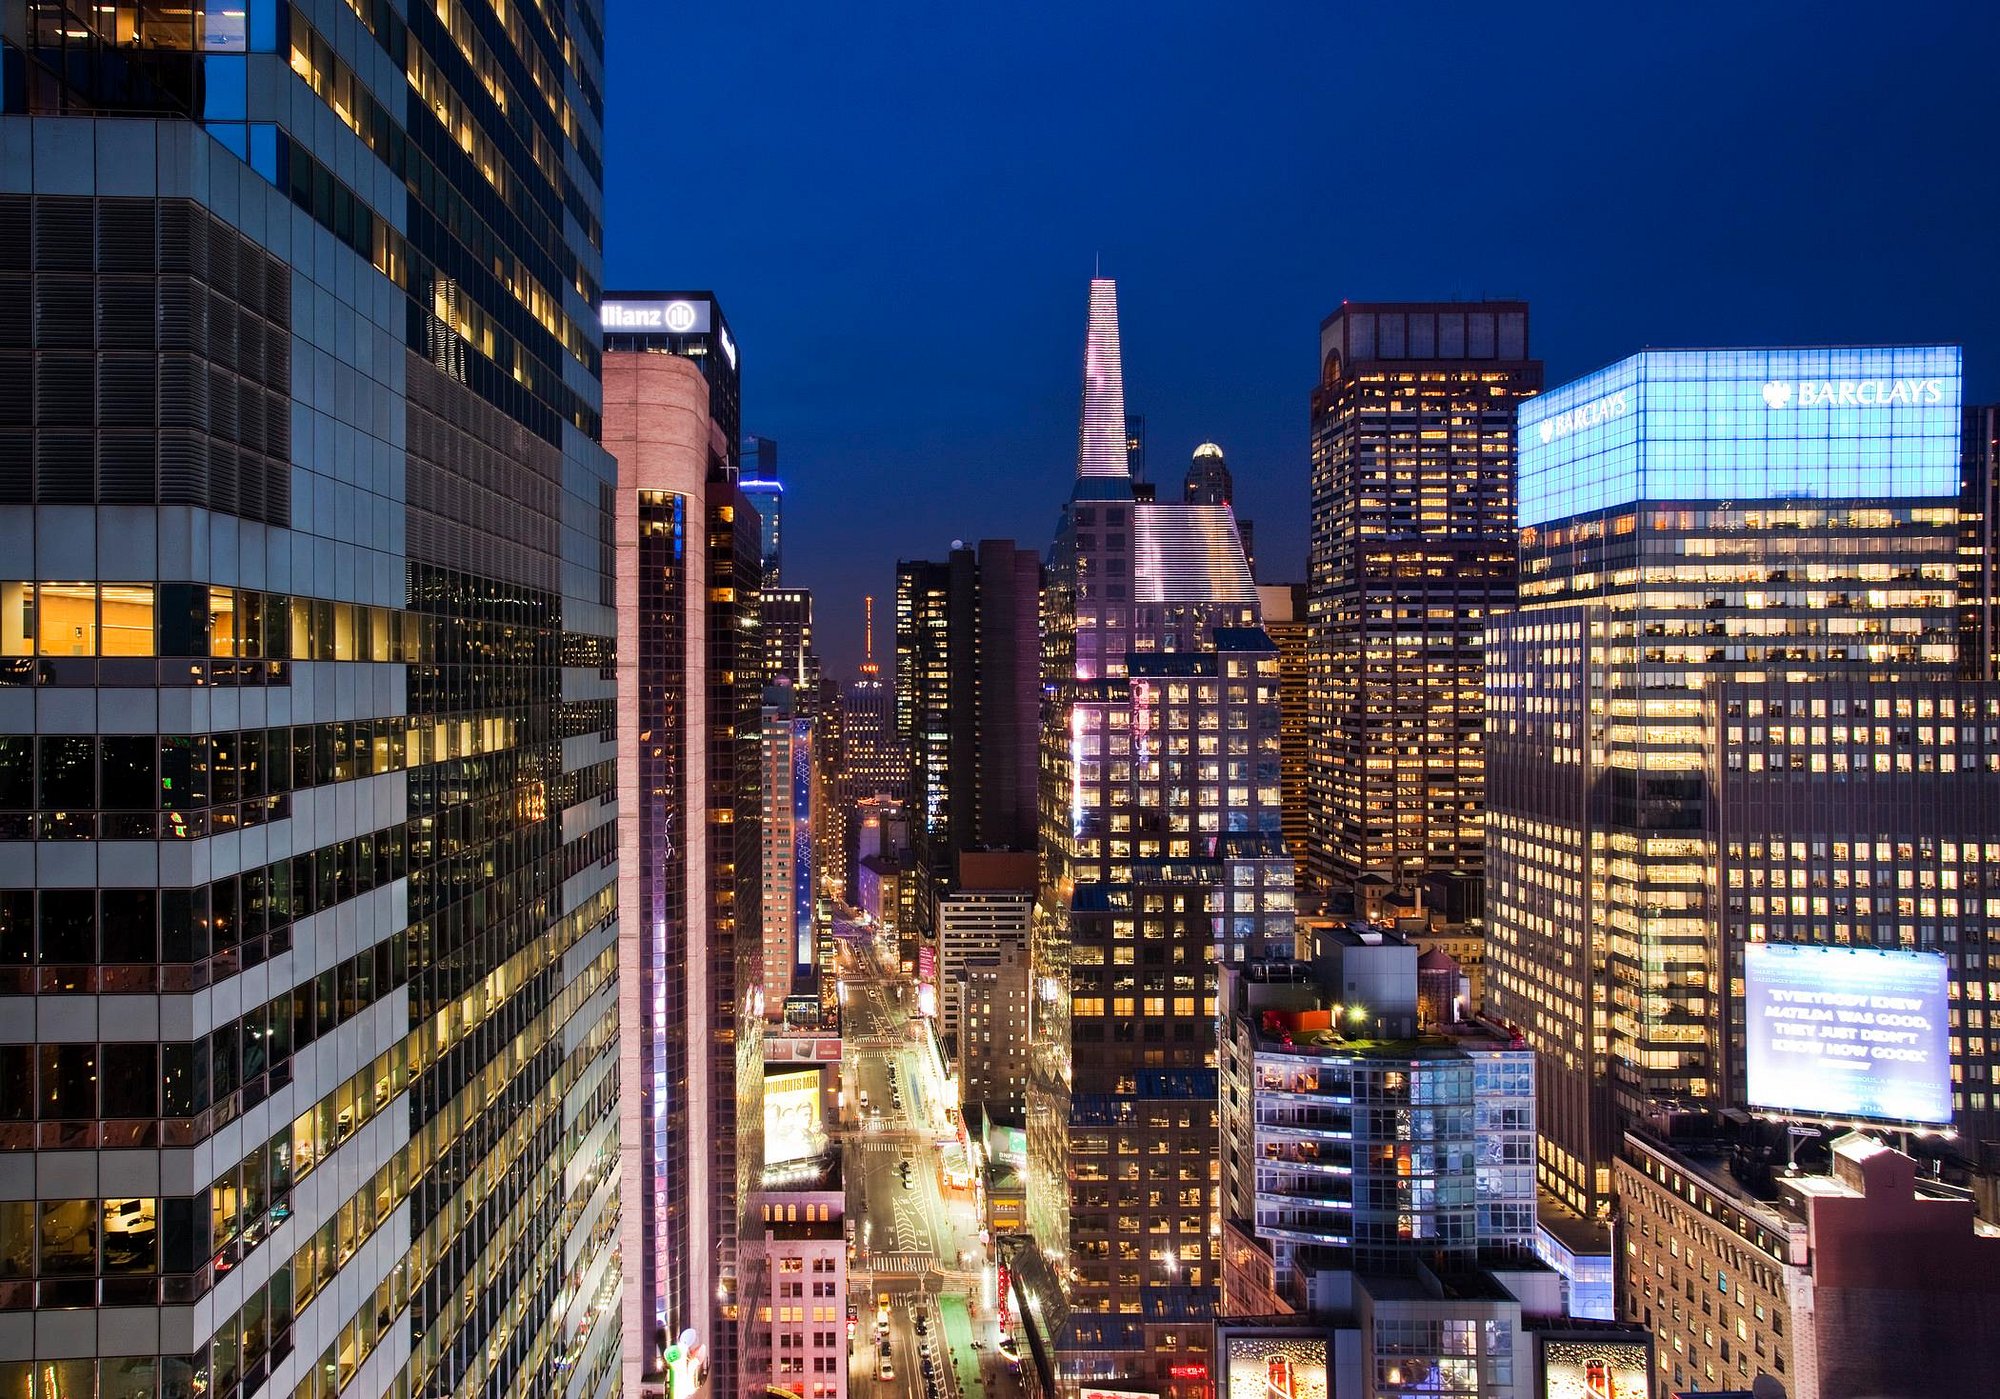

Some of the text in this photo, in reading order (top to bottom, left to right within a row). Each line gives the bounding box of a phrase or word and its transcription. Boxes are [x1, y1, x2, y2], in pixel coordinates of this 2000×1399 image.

[602, 305, 661, 325] llianz
[1798, 379, 1943, 405] BARCLAYS
[1556, 391, 1626, 436] BARCLAYS
[1764, 1005, 1931, 1031] MATILDA WAS GOOD,
[1773, 1022, 1817, 1037] THEY
[1818, 1026, 1858, 1040] JUST
[1826, 1043, 1868, 1057] HOW
[802, 1075, 818, 1090] MEN
